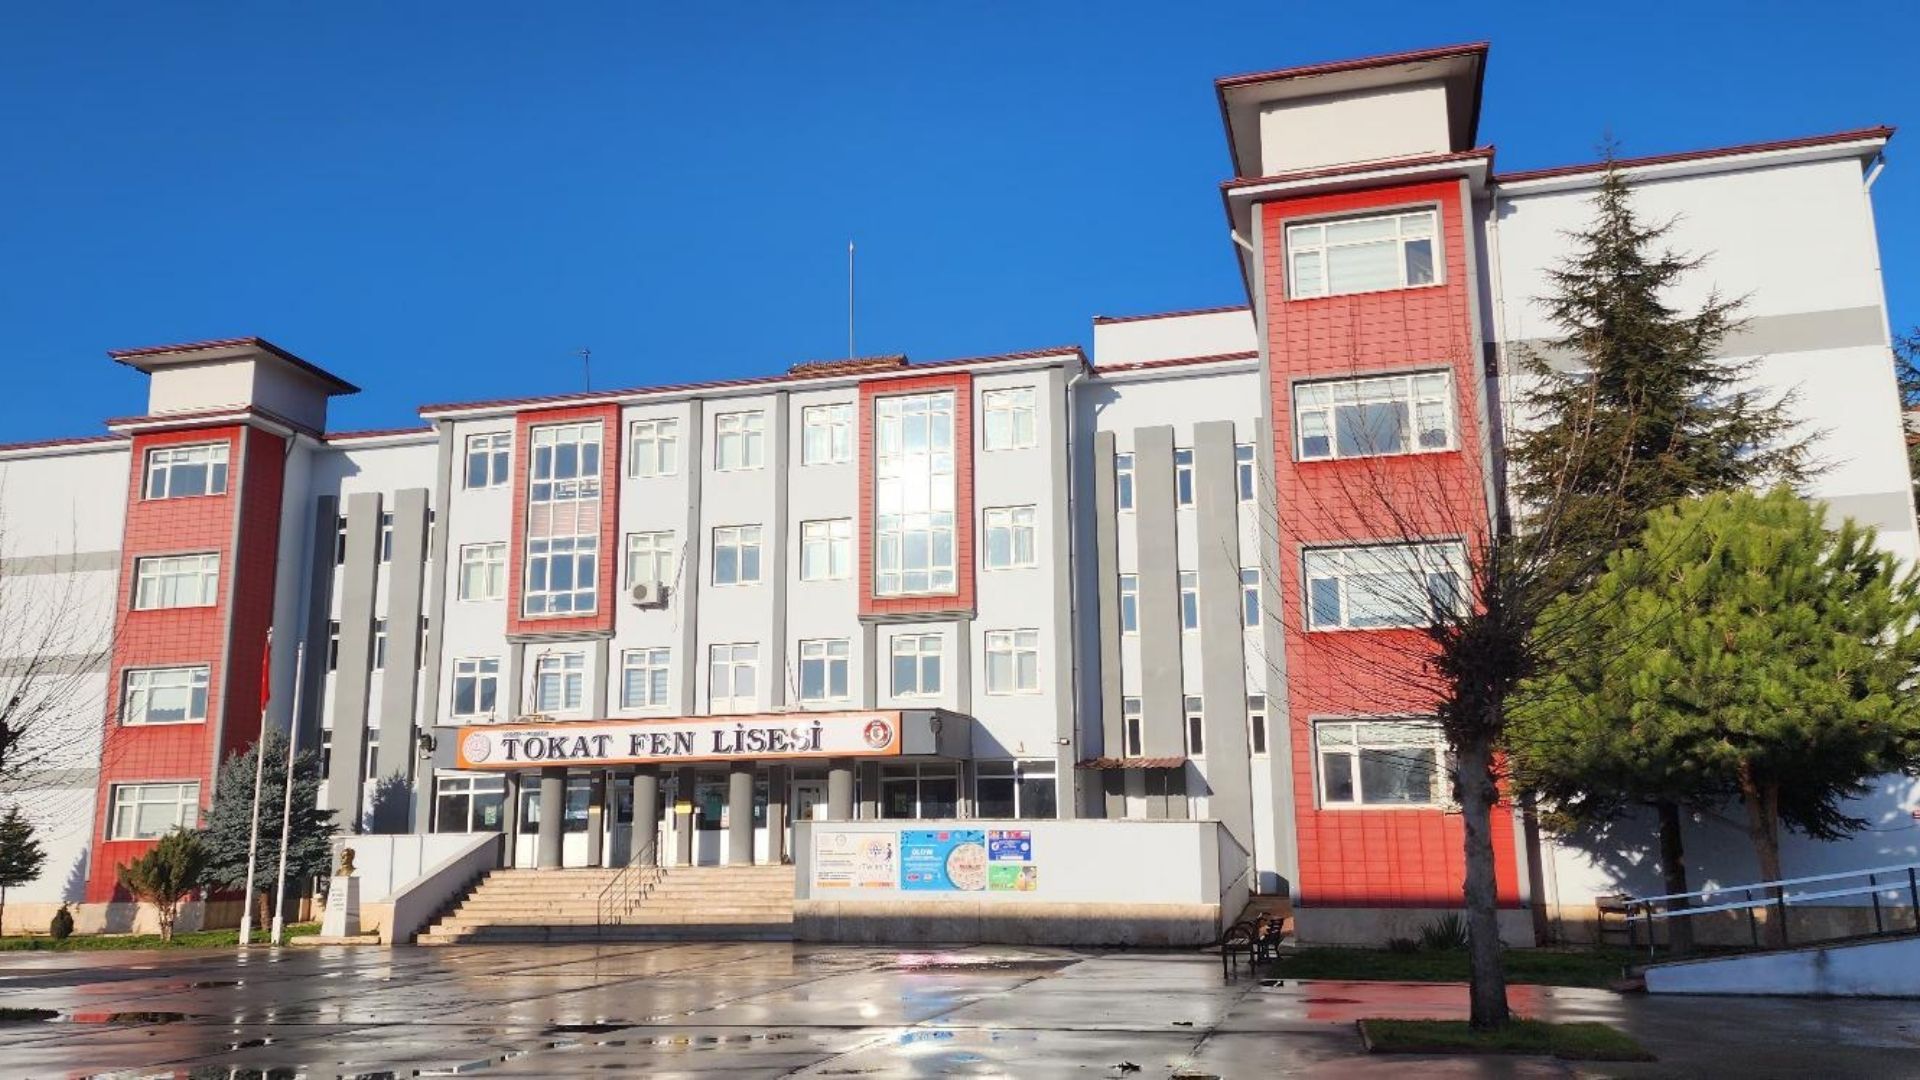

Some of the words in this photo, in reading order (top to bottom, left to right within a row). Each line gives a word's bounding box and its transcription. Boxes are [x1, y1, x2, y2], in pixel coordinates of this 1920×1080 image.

[501, 733, 613, 761] TOKAT
[628, 730, 696, 757] FEN
[711, 719, 824, 754] LİSESİ
